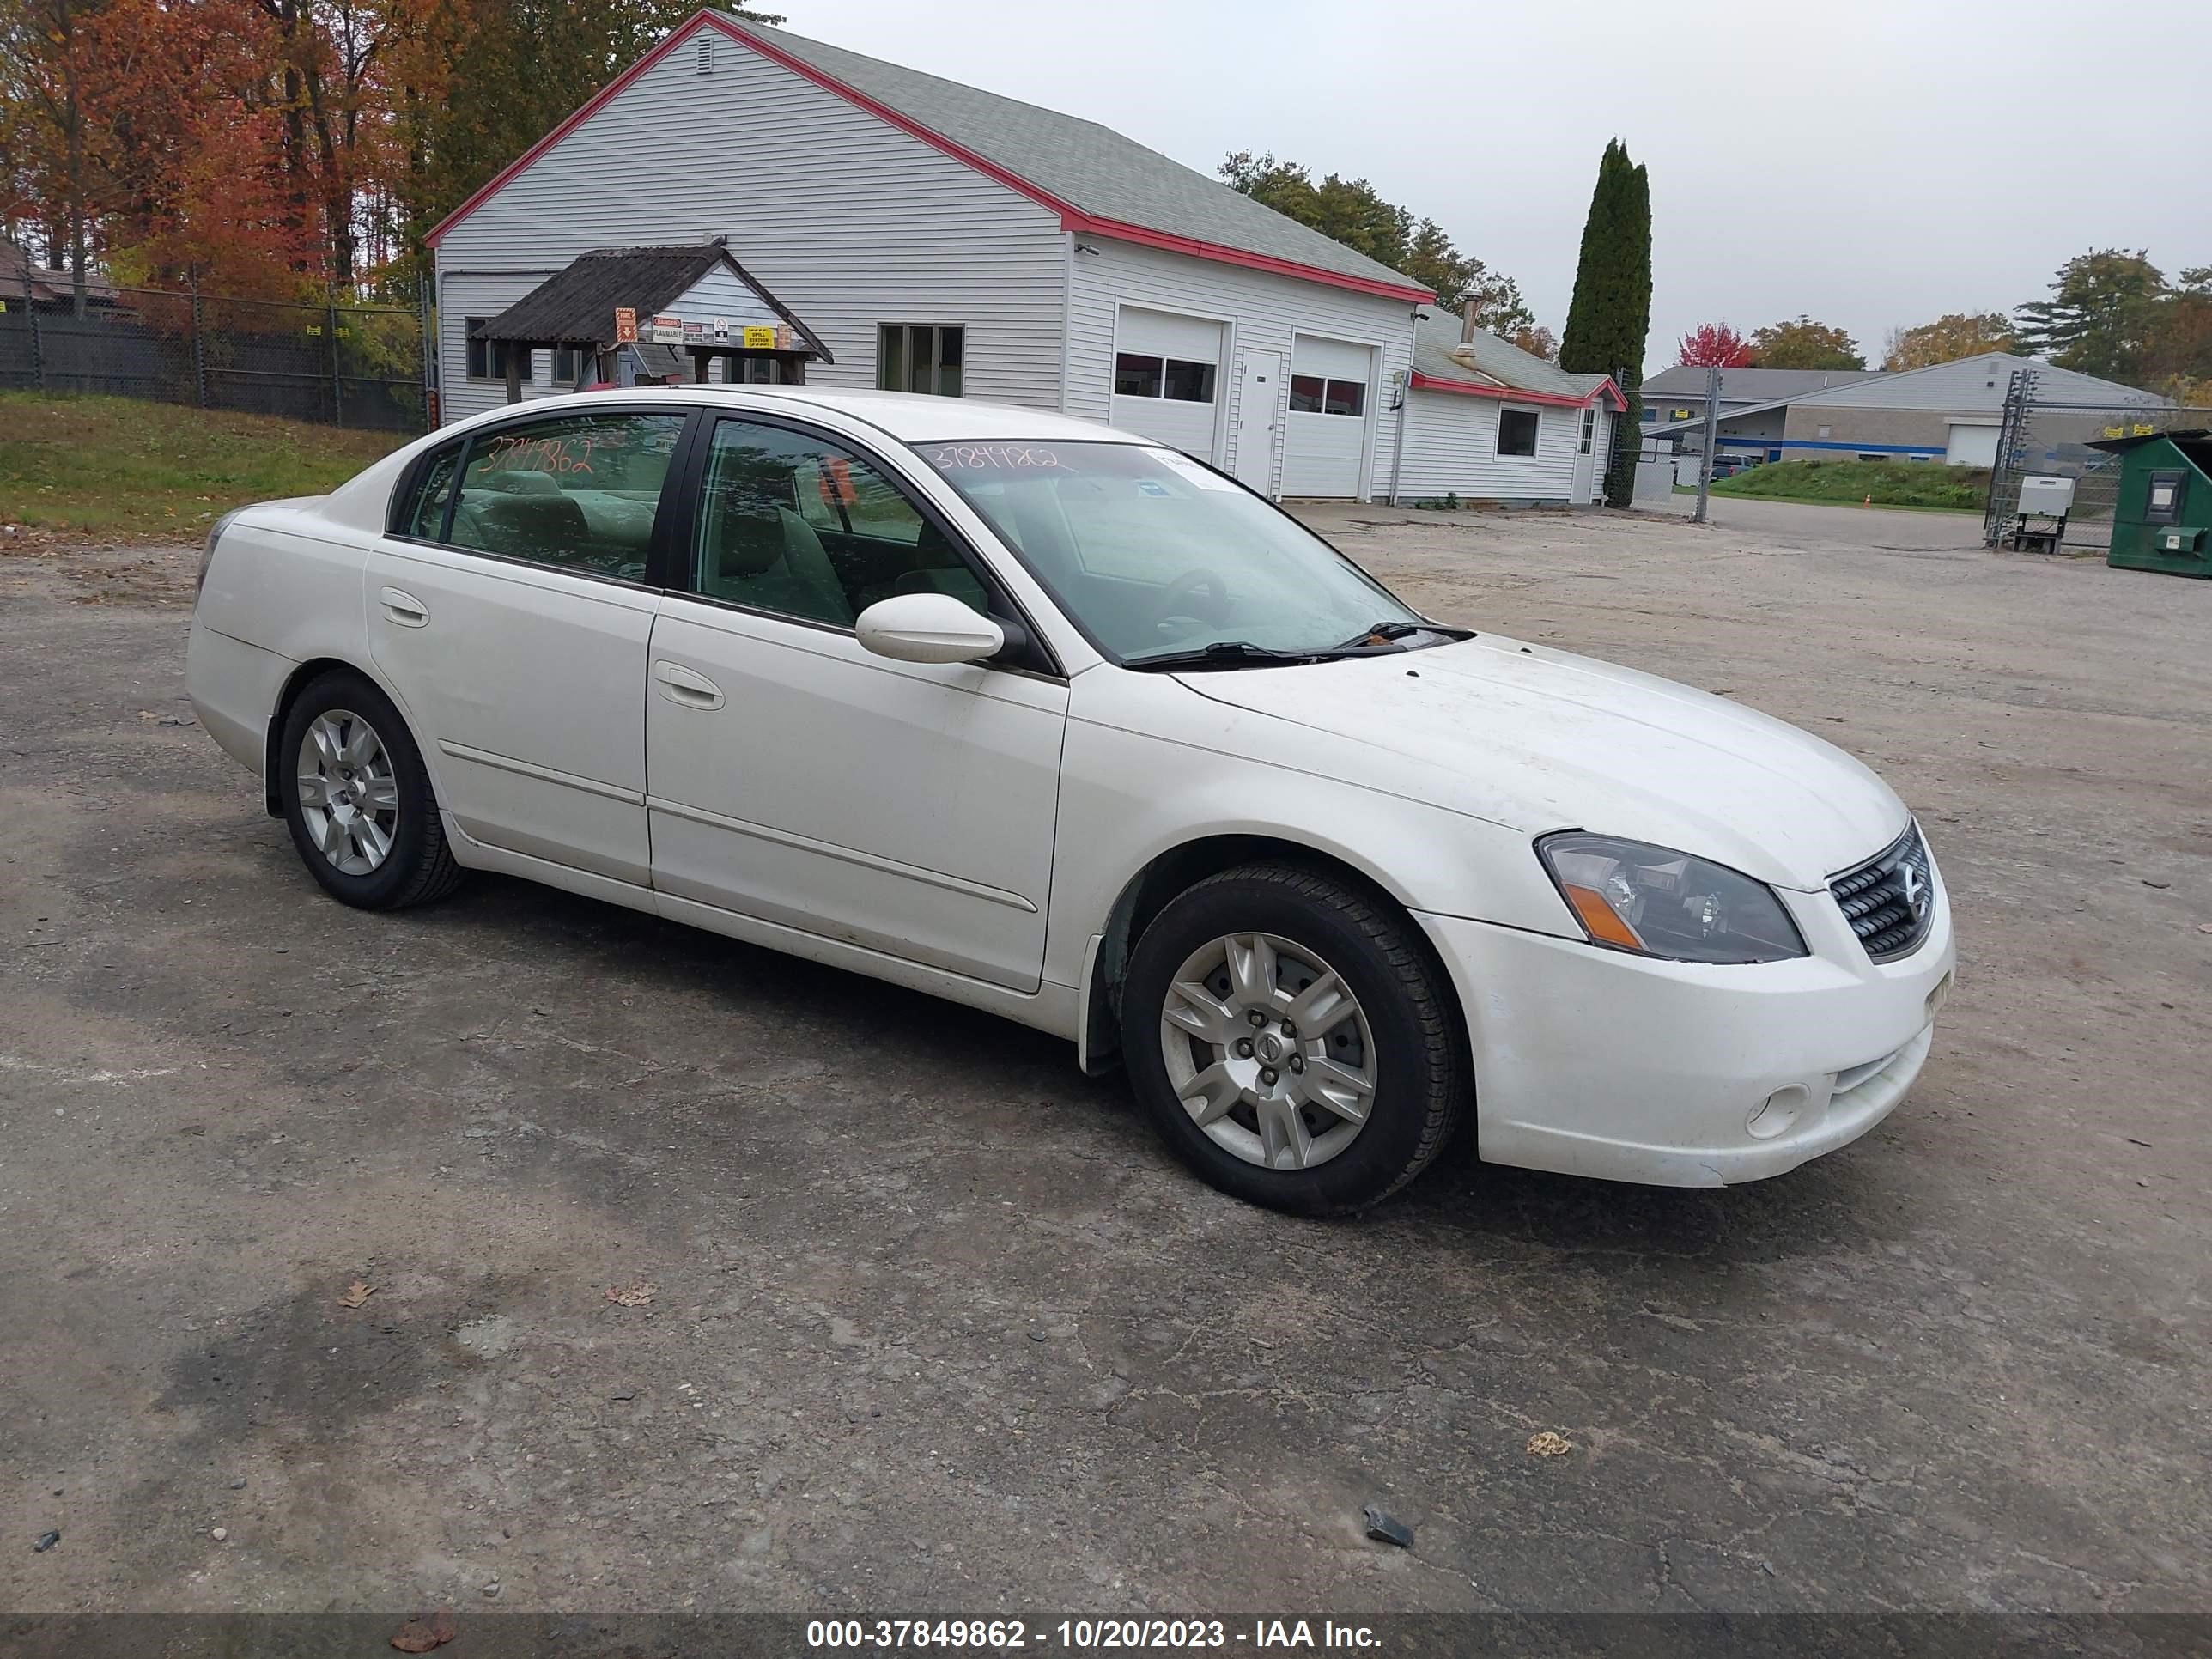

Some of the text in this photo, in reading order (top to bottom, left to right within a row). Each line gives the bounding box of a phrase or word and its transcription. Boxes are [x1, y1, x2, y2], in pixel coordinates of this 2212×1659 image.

[656, 317, 678, 326] DANGER
[653, 329, 682, 338] FLAMMABLE
[477, 435, 592, 474] 37849862
